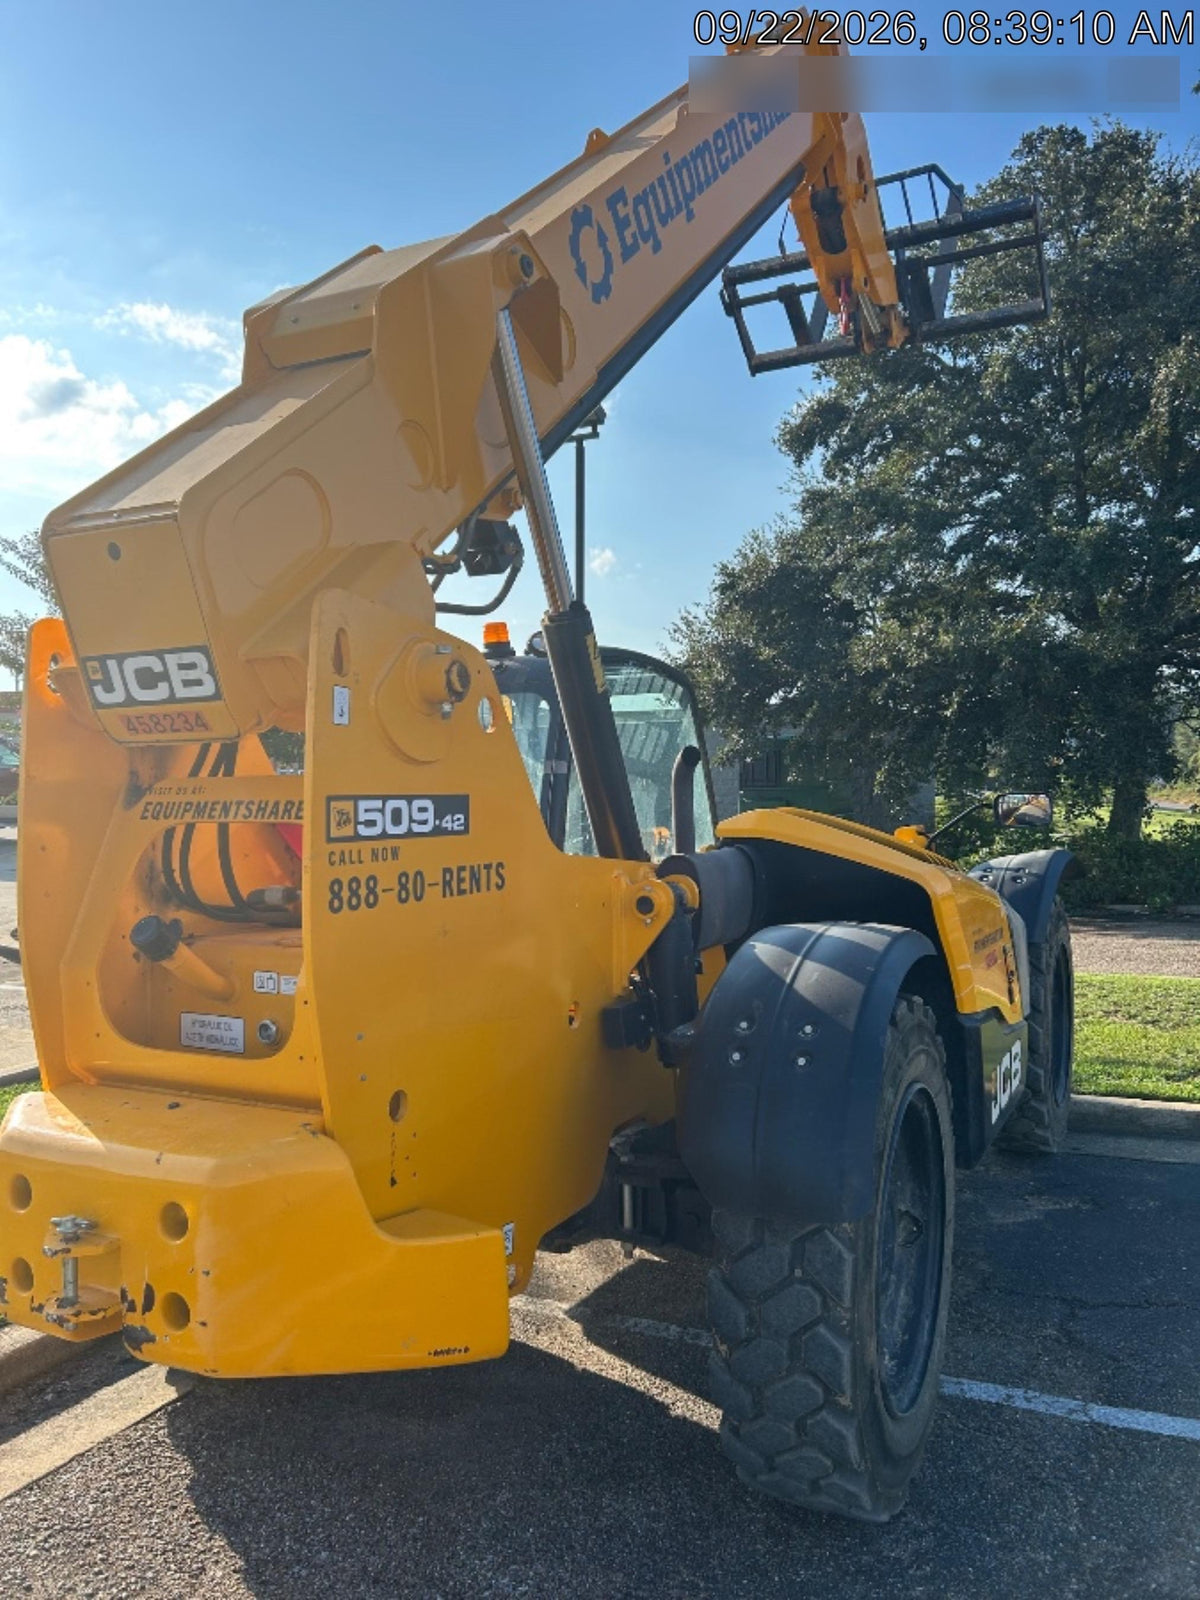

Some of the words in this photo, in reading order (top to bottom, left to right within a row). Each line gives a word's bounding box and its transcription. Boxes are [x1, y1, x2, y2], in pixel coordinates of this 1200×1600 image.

[93, 652, 216, 704] JCB
[126, 713, 209, 735] 458234
[328, 849, 364, 867] CALL
[371, 846, 401, 863] NOW
[328, 862, 506, 914] 888-80-RENTS
[991, 1039, 1022, 1125] JCB
